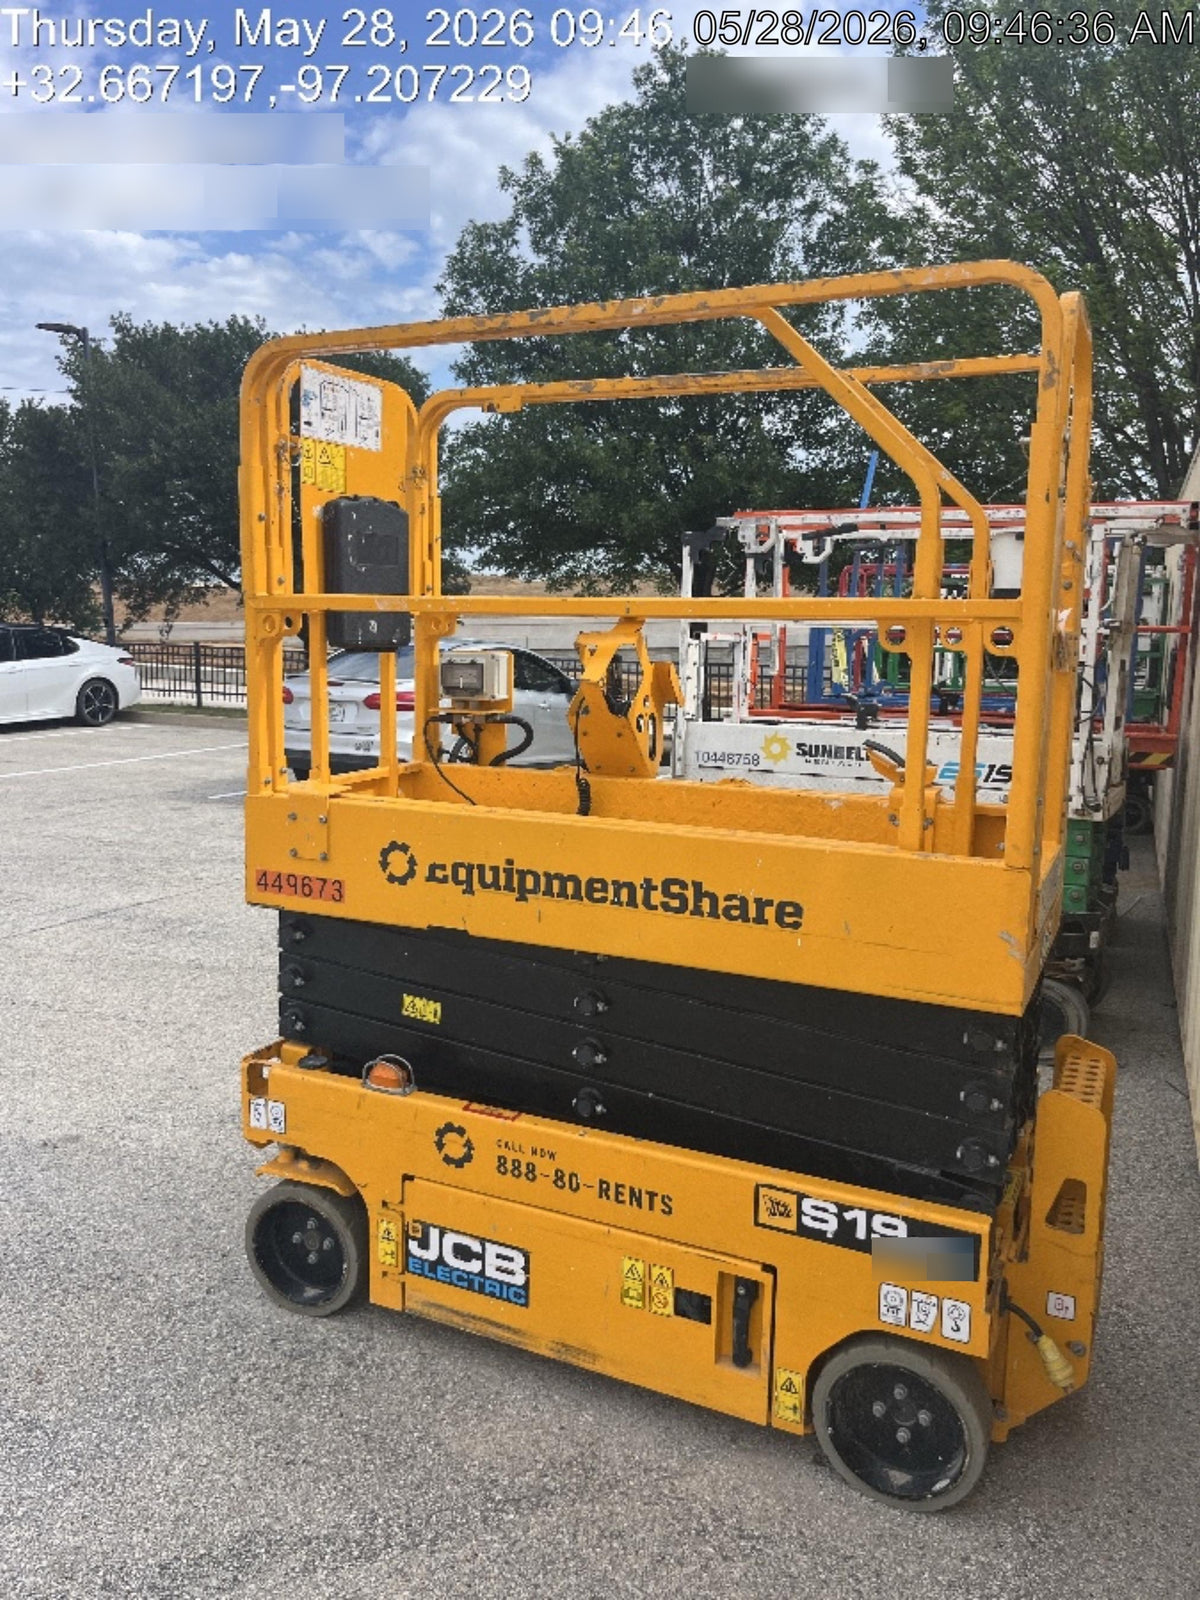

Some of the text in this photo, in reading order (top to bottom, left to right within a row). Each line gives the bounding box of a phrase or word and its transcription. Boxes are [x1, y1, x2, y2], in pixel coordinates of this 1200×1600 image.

[256, 870, 344, 903] 449673
[496, 1139, 557, 1162] CALL NOW
[496, 1155, 674, 1216] 888-80-RENTS
[408, 1226, 527, 1287] JCB
[408, 1256, 527, 1305] ELECTRIC
